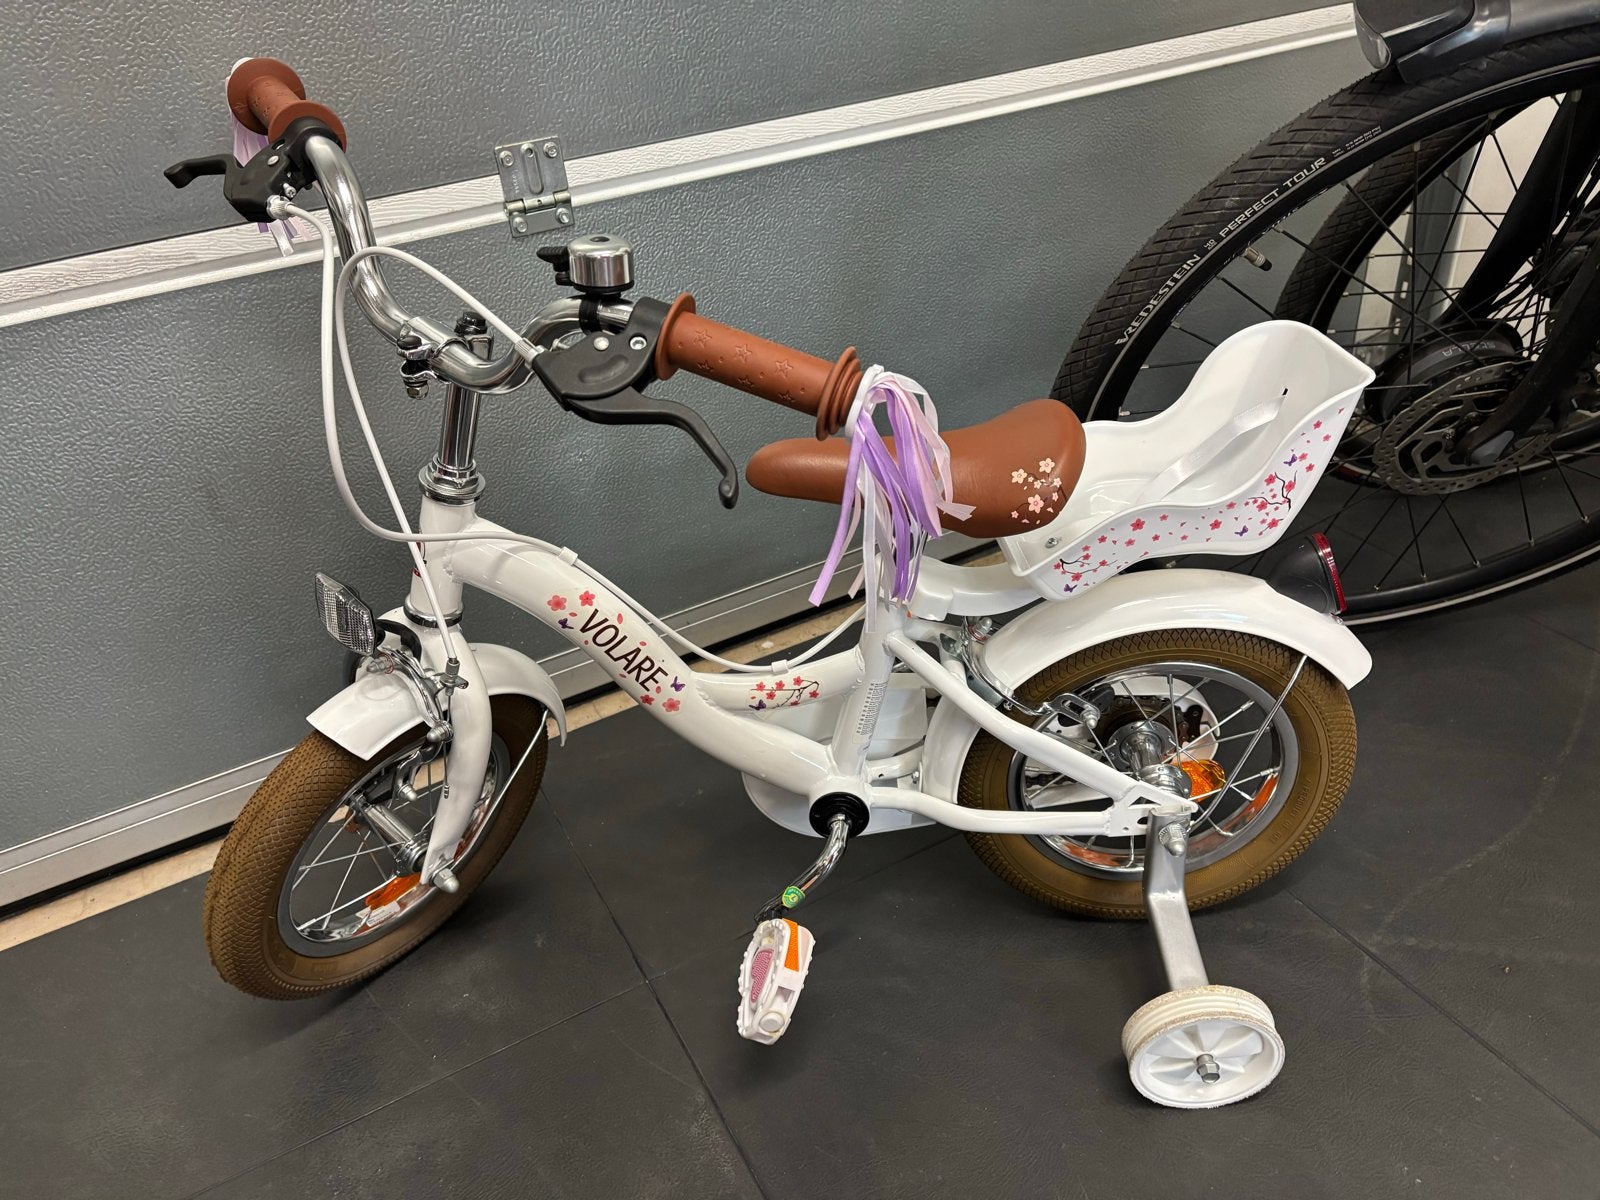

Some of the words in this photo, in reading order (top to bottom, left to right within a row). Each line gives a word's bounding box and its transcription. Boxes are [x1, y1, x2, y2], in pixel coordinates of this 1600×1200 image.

[1114, 254, 1201, 345] VREDESTEIN
[1219, 188, 1279, 238] PERFECT
[1282, 157, 1327, 188] TOUR
[579, 608, 669, 692] VOLARE
